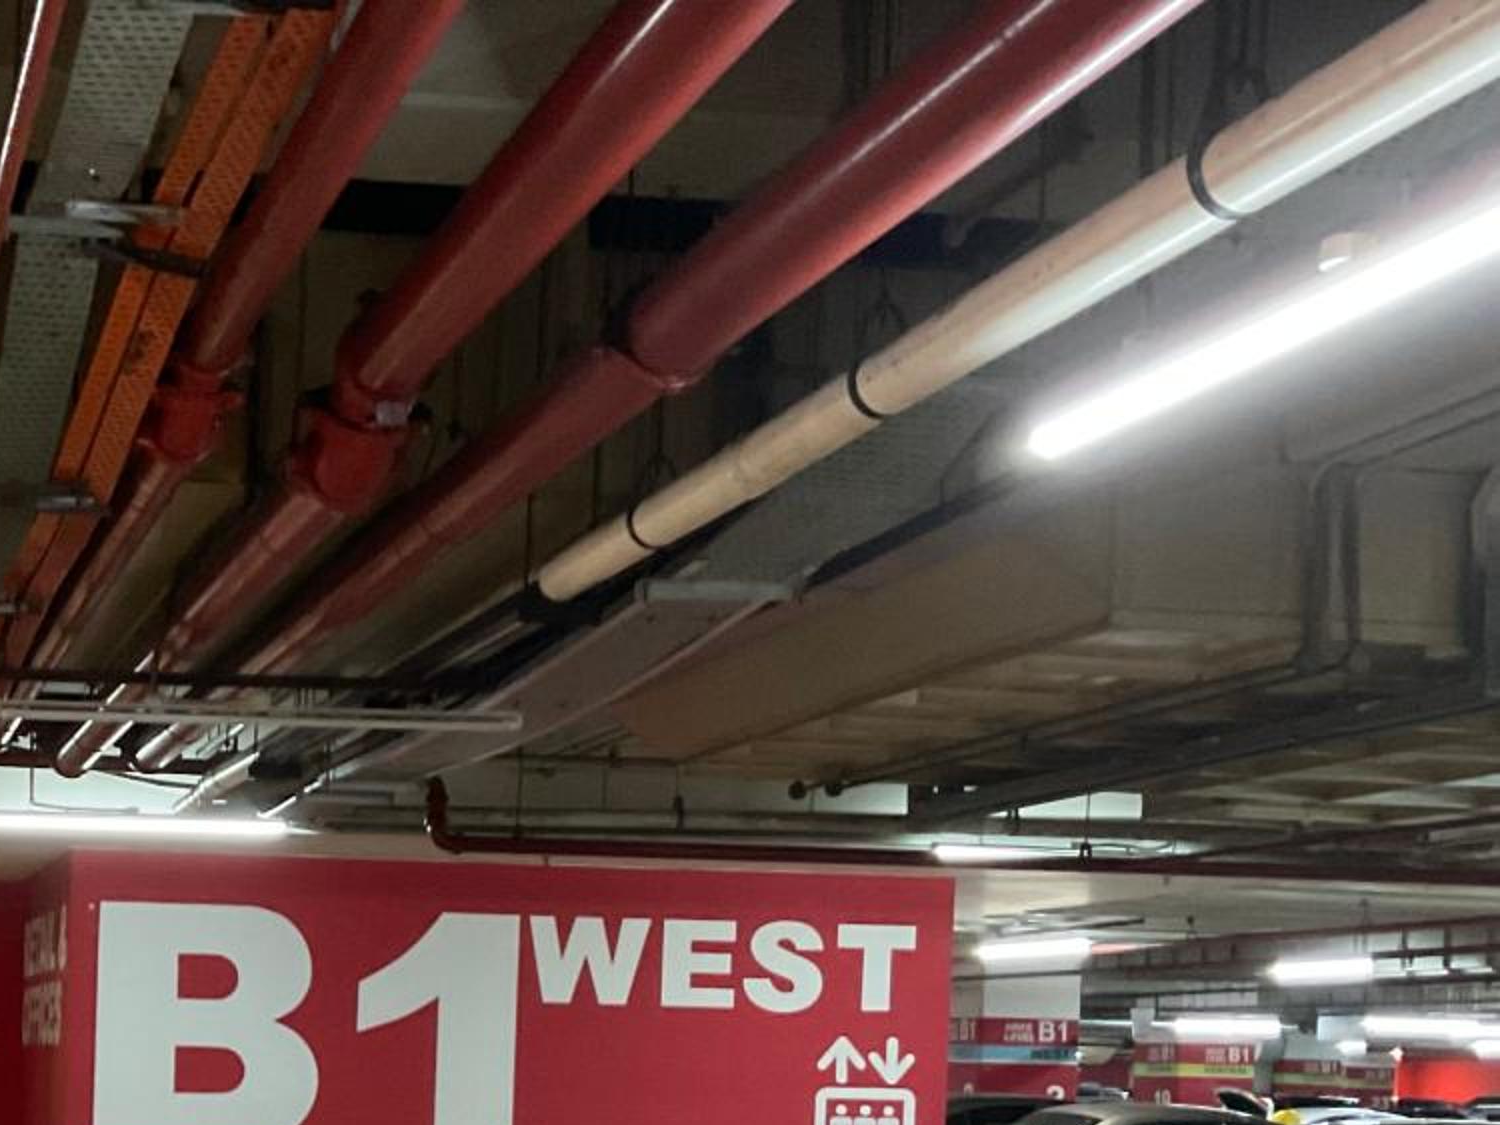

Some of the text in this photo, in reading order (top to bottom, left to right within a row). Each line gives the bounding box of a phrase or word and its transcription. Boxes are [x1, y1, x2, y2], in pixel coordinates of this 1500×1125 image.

[529, 915, 917, 1013] WEST
[1038, 1020, 1068, 1043] B1
[1228, 1045, 1249, 1063] B1
